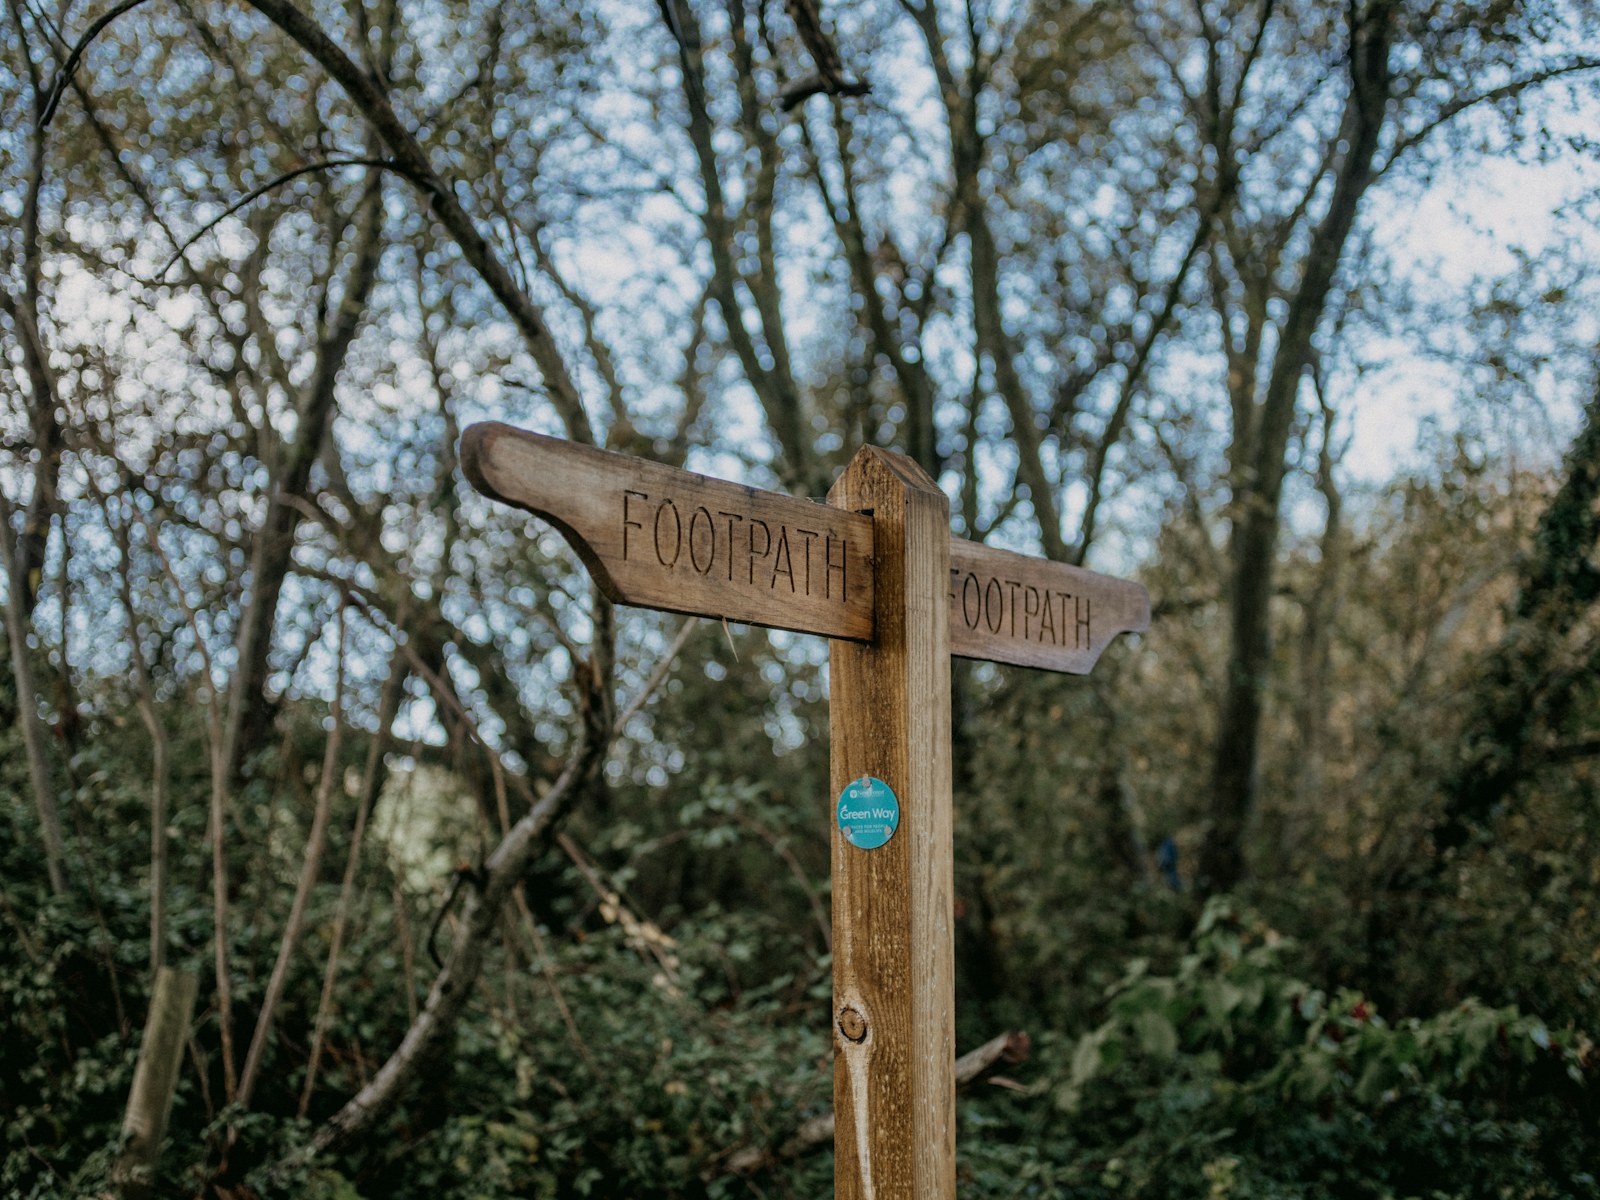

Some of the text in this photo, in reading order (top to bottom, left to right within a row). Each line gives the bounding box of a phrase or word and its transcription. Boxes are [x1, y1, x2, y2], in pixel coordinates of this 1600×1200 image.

[623, 489, 847, 603] FOOTPATH
[840, 808, 895, 821] Green Way
